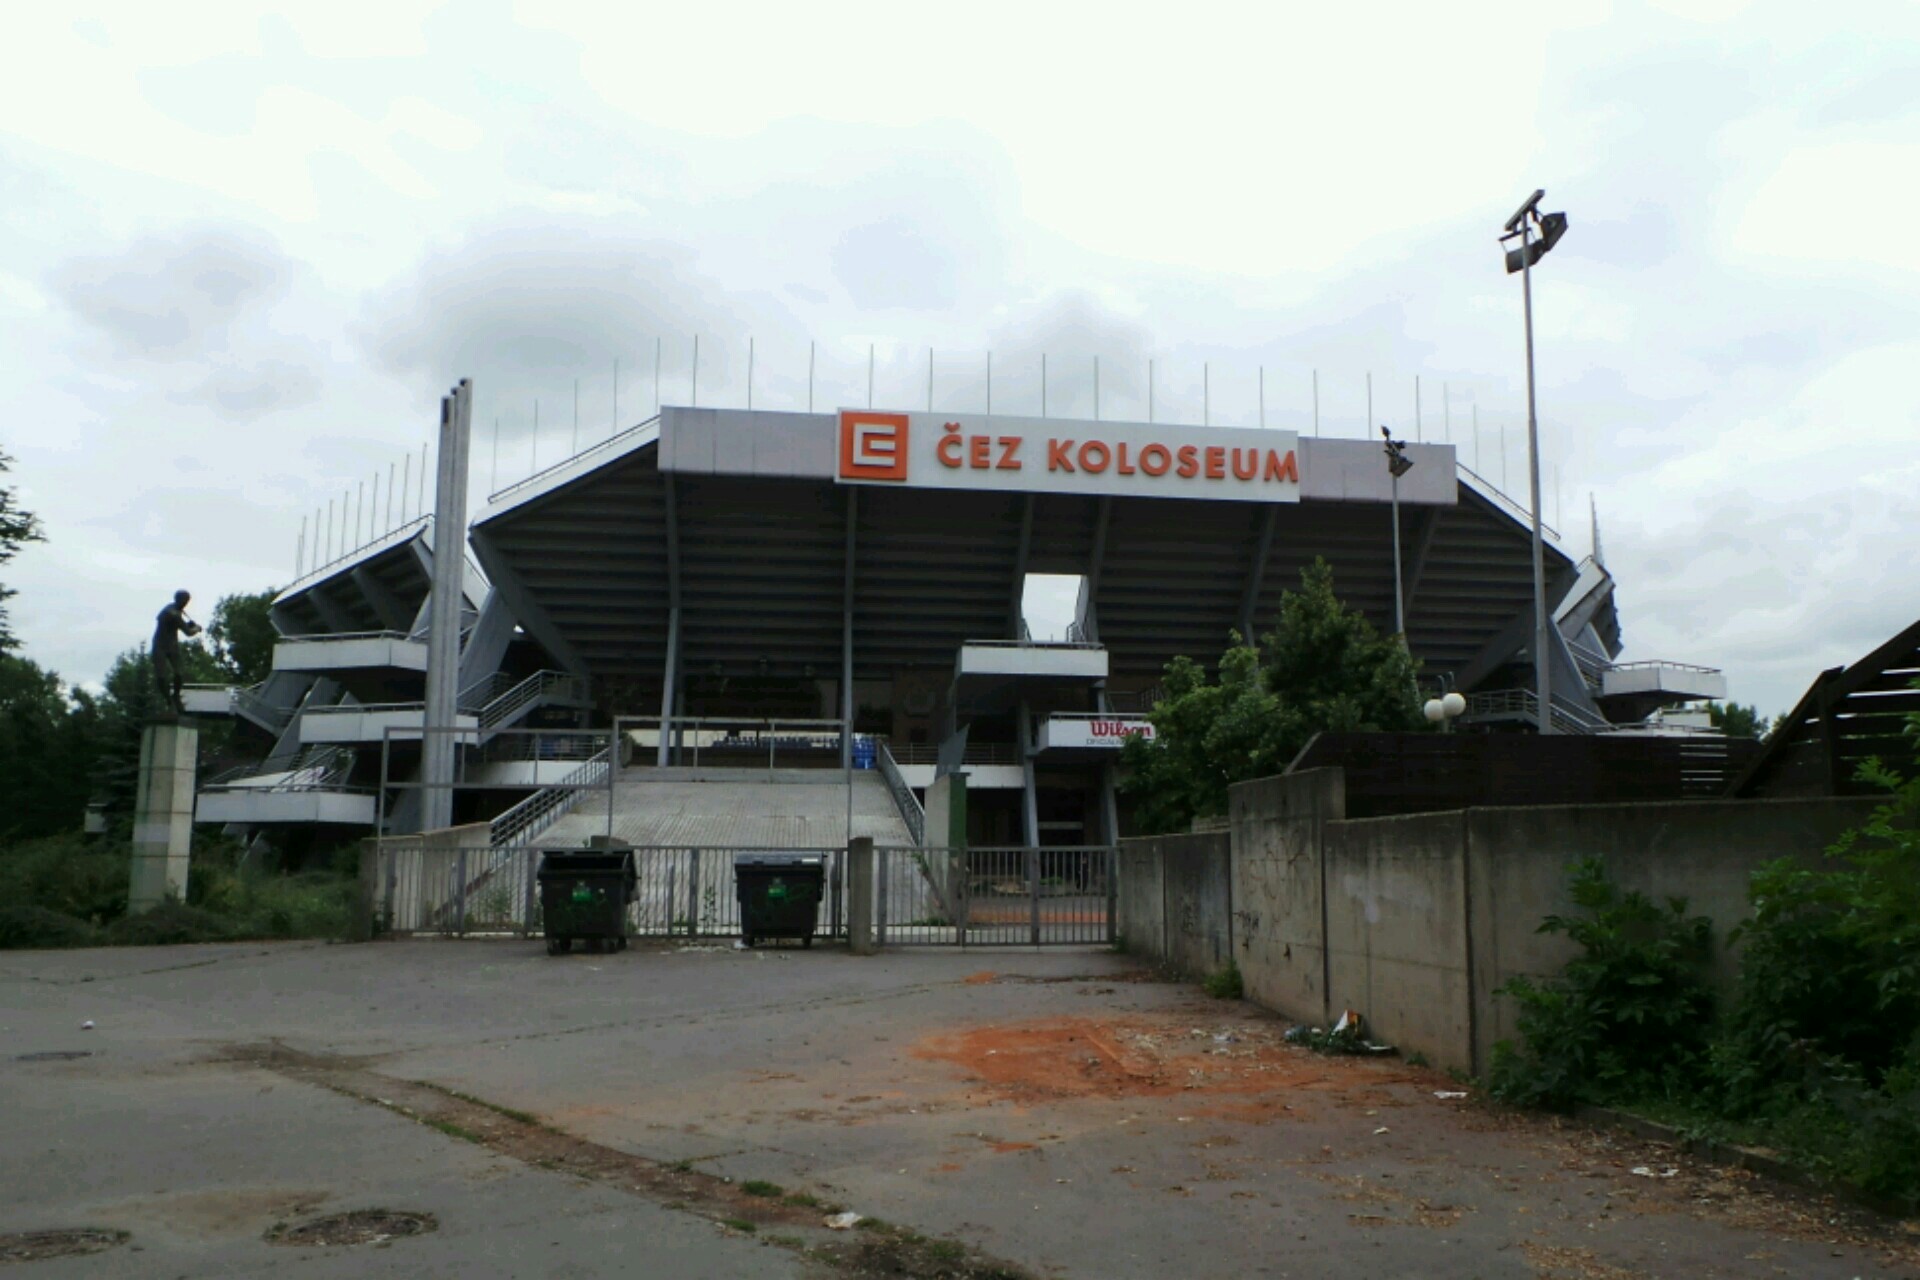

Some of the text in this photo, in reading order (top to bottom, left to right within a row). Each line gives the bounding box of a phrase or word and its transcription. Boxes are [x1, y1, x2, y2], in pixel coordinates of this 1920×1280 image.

[936, 423, 1299, 483] ČEZ KOLOSEUM
[1091, 720, 1151, 737] Wilson
